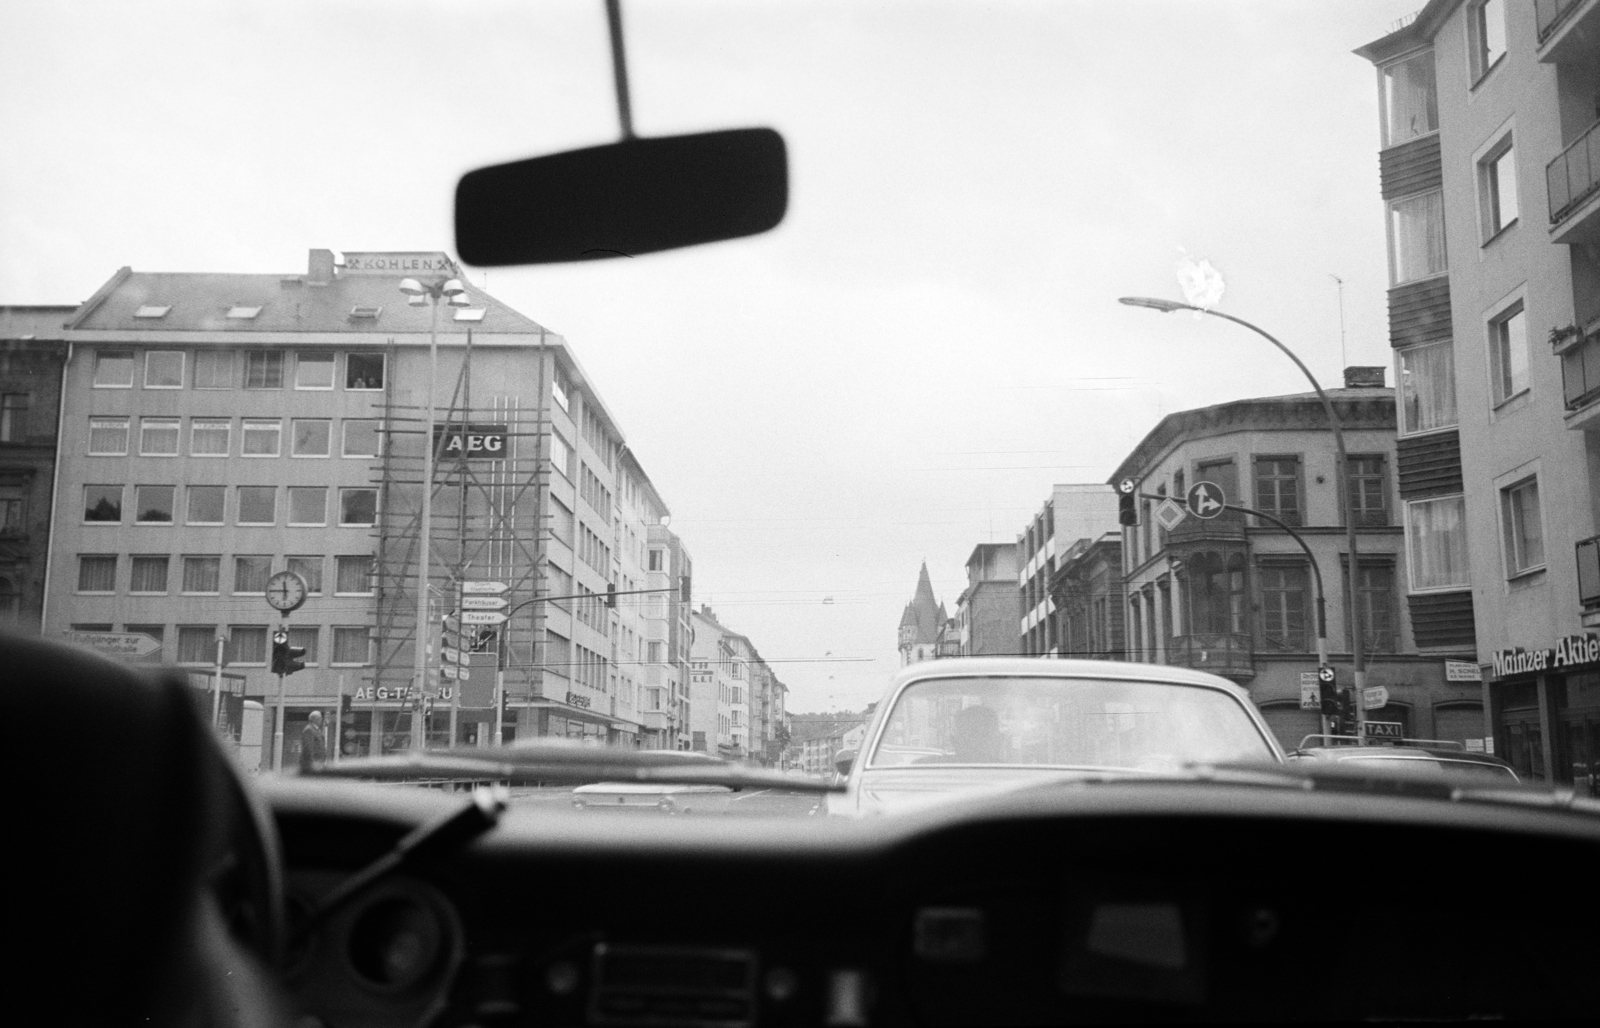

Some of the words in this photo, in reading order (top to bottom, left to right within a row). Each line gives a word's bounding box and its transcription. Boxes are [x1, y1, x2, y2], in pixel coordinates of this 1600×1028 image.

[364, 259, 432, 270] KOHLEN
[446, 435, 502, 452] AEG
[467, 613, 495, 621] Theater
[125, 637, 140, 645] zur
[1492, 648, 1549, 677] Mainzer
[1553, 632, 1600, 667] Aktie
[1366, 724, 1399, 736] TAXI
